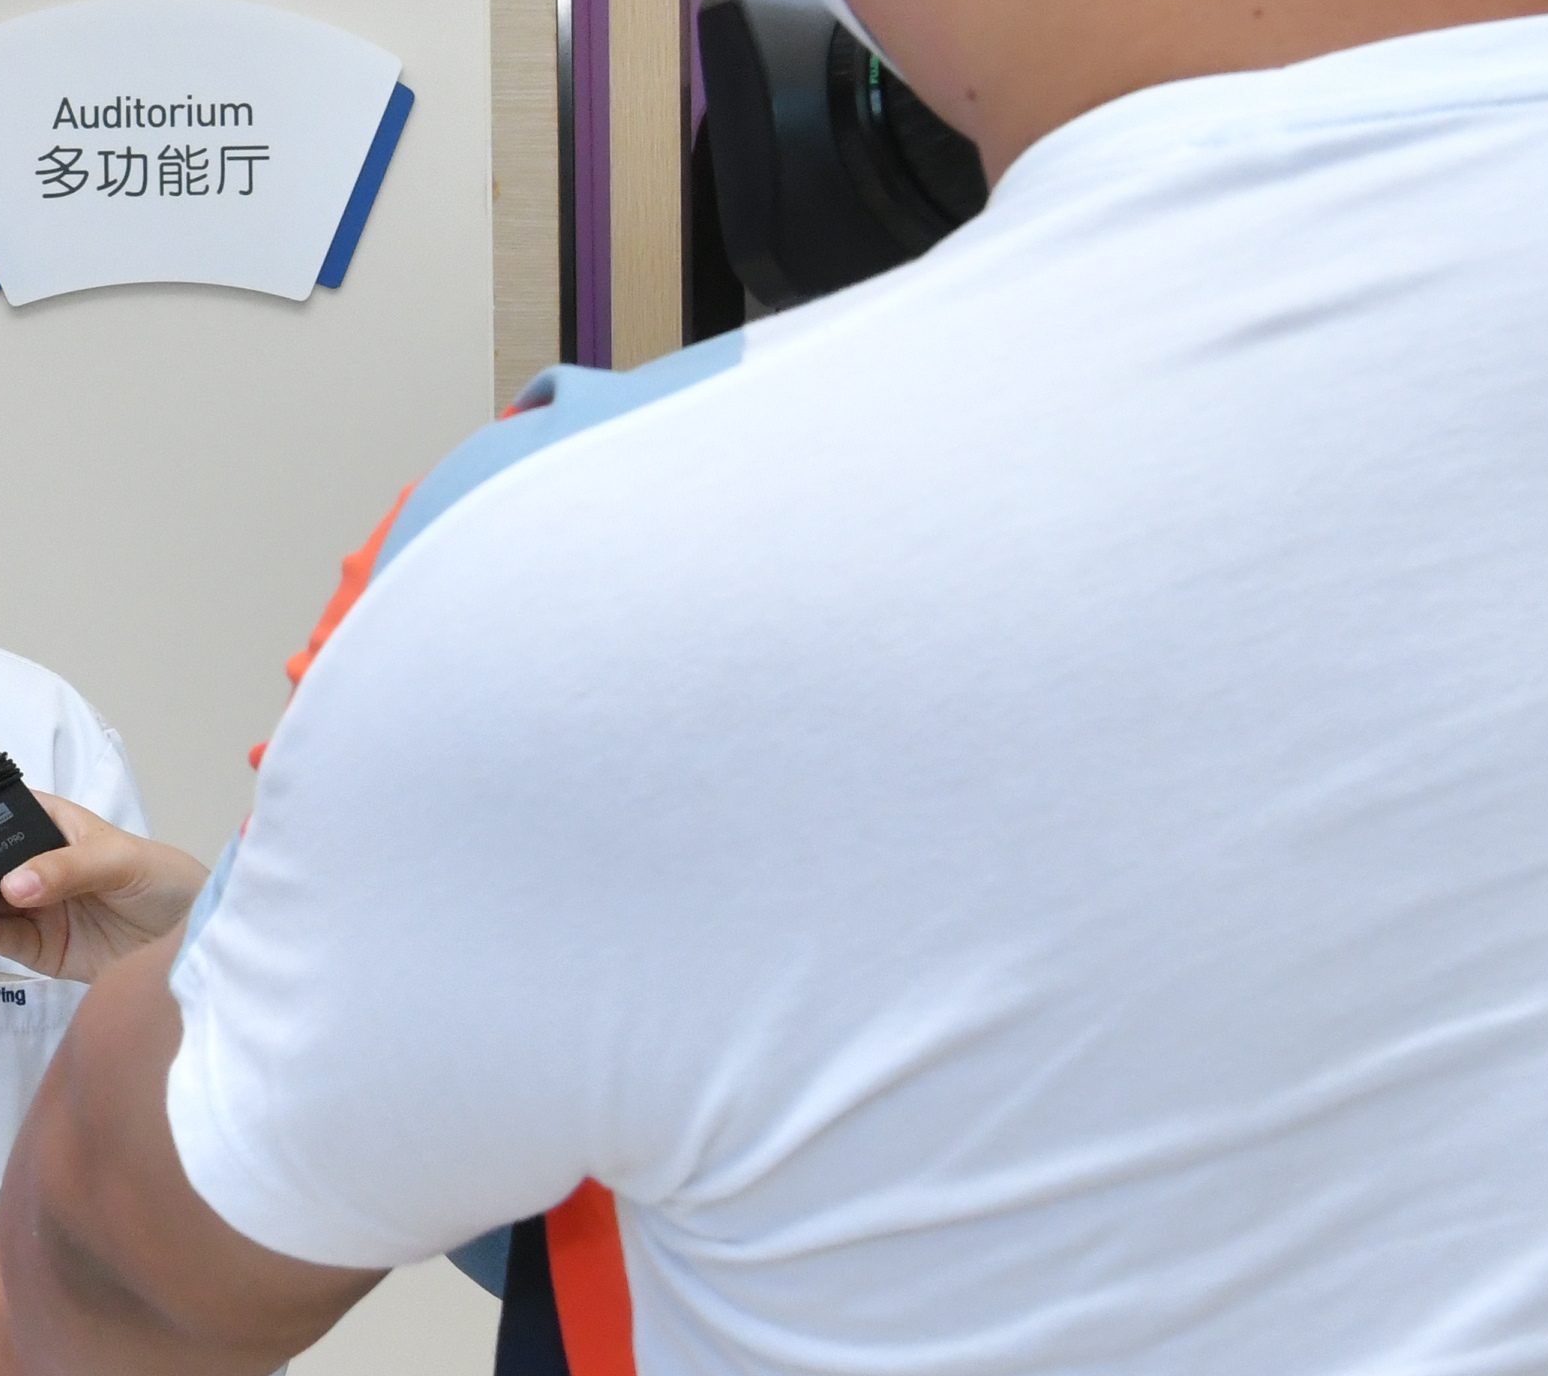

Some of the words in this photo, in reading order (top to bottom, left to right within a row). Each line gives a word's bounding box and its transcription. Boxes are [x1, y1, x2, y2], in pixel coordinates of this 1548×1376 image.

[51, 94, 254, 130] Auditorium
[34, 143, 271, 200] 多功能厅
